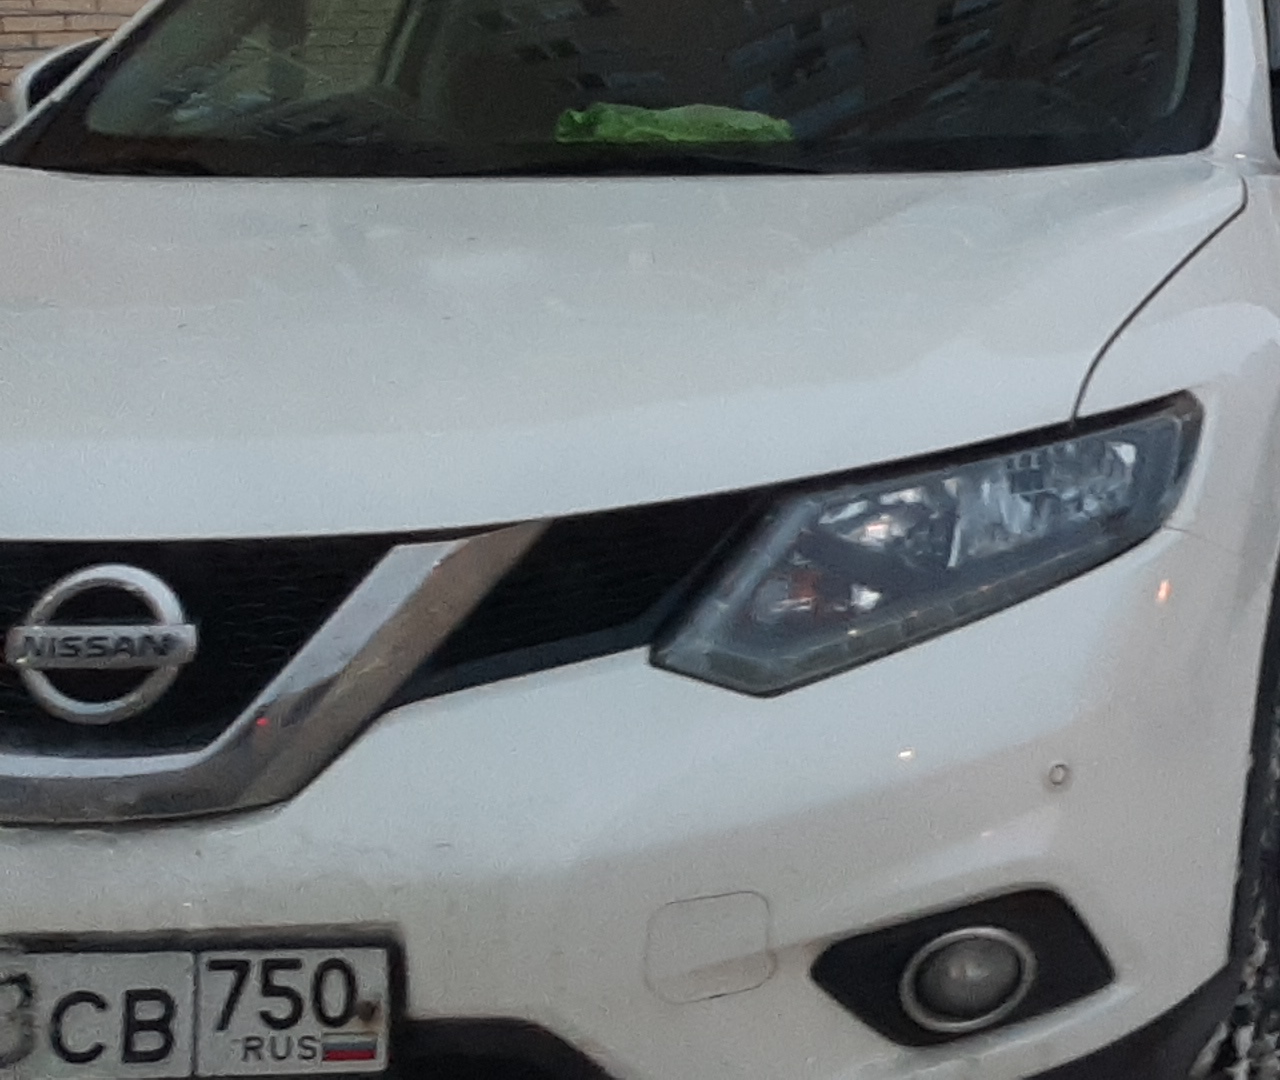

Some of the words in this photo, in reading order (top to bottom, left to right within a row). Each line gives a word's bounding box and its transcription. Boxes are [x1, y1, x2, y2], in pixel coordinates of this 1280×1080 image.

[24, 634, 173, 658] NISSAN
[205, 957, 357, 1031] 750
[241, 1034, 319, 1063] RUS
